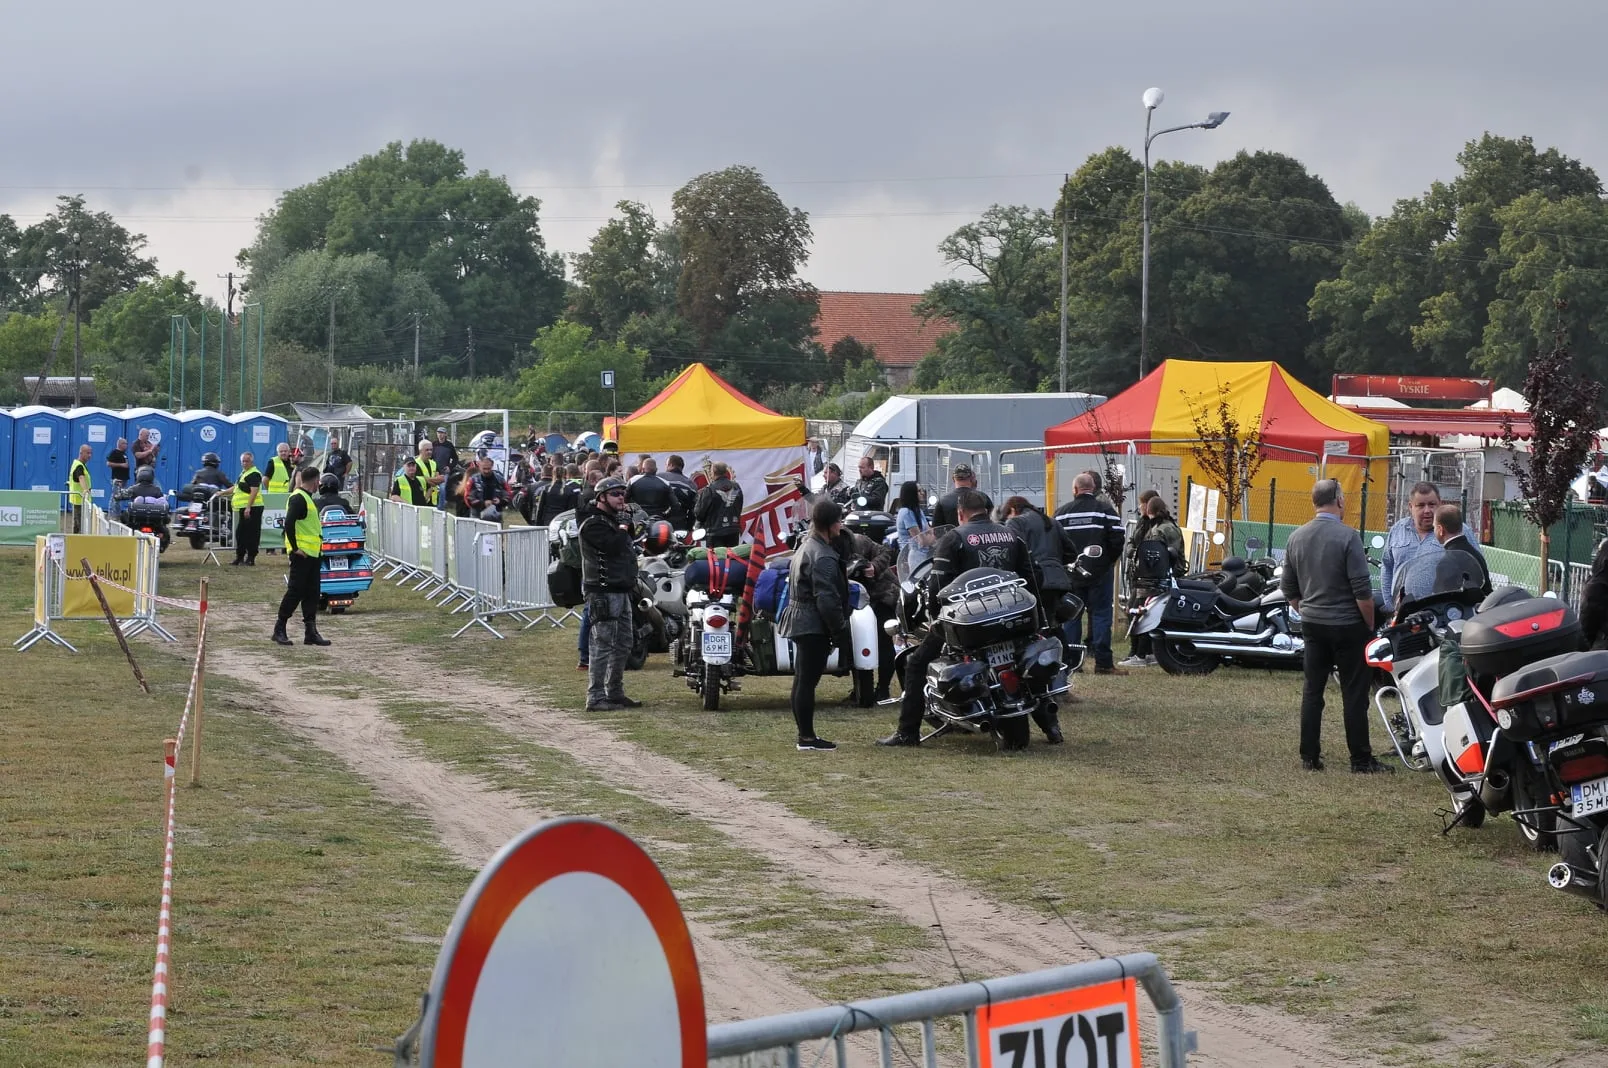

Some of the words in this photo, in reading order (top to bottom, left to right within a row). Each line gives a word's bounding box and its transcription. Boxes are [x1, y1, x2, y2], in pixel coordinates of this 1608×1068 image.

[1400, 385, 1430, 394] TYSKIE
[979, 532, 1014, 545] YAMAHA
[66, 562, 132, 586] wwtelka.pl
[710, 635, 726, 643] DGR
[1583, 780, 1607, 797] DMI
